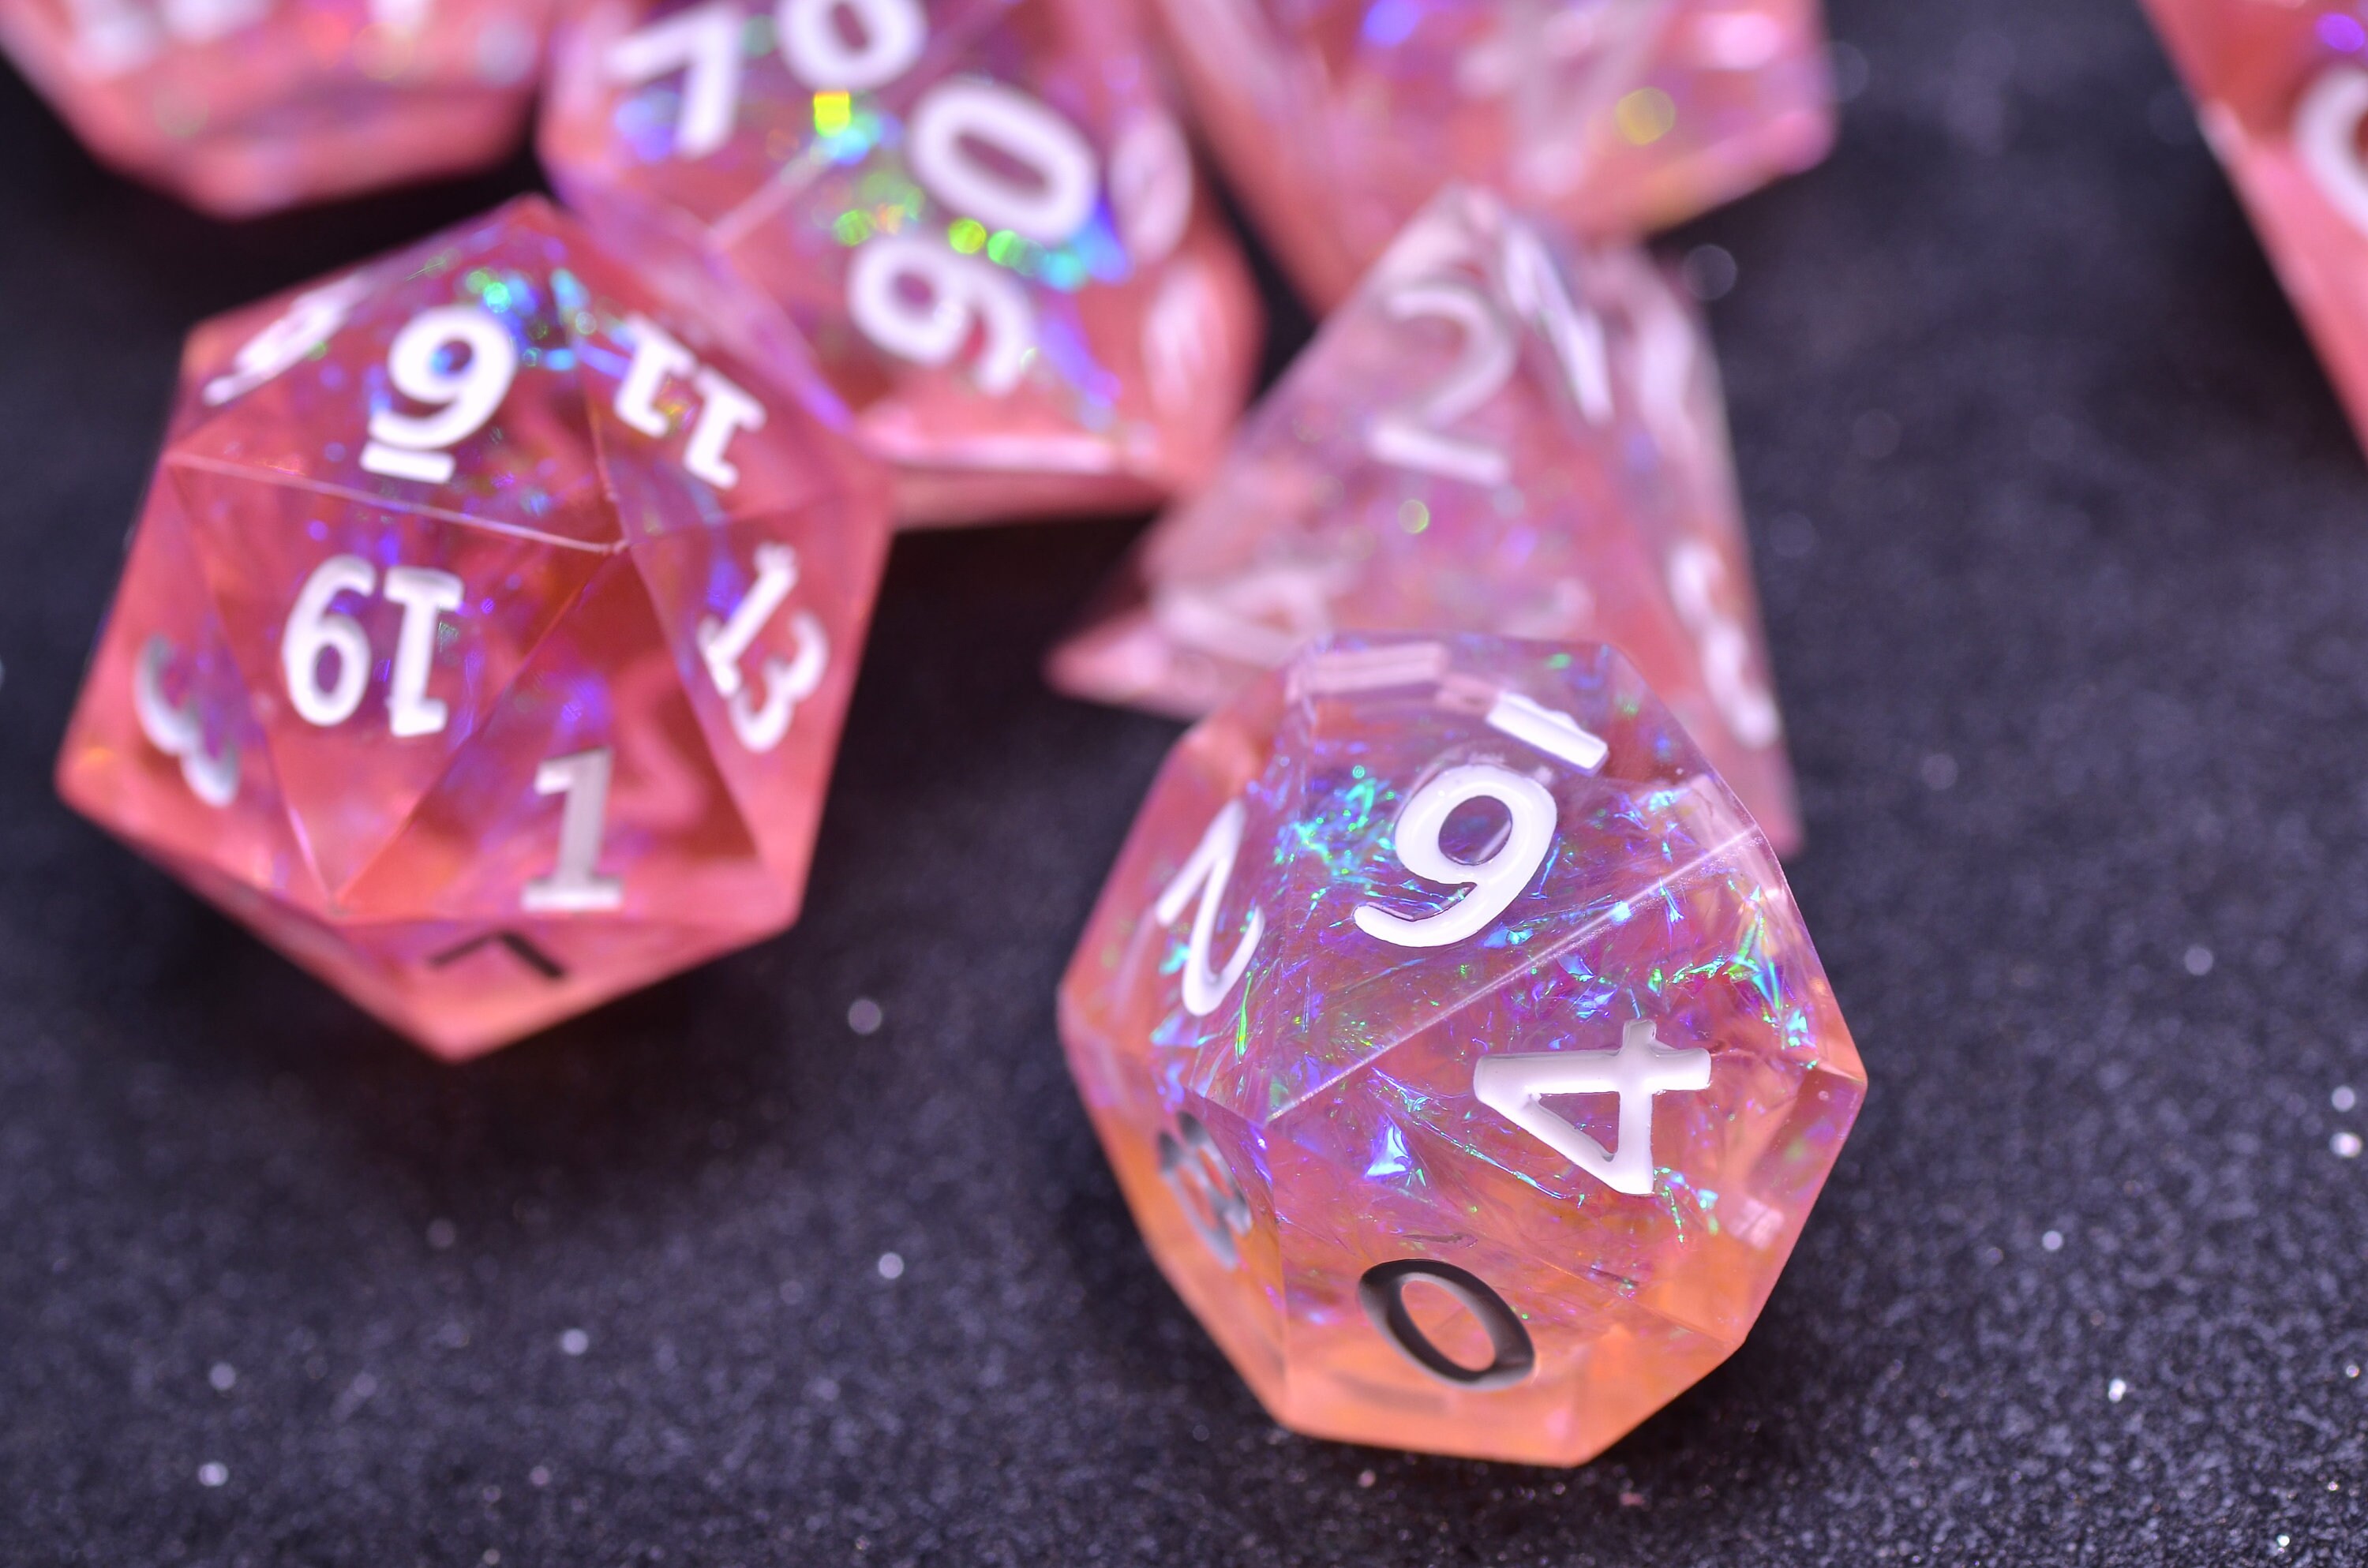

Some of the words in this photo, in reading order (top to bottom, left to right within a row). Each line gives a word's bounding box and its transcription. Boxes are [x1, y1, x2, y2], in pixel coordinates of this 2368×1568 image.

[614, 314, 766, 489] 11
[283, 555, 464, 736] 19
[697, 542, 829, 752] 13
[521, 746, 624, 912] 1
[1474, 1018, 1711, 1195] 4
[1358, 1258, 1535, 1392] 0
